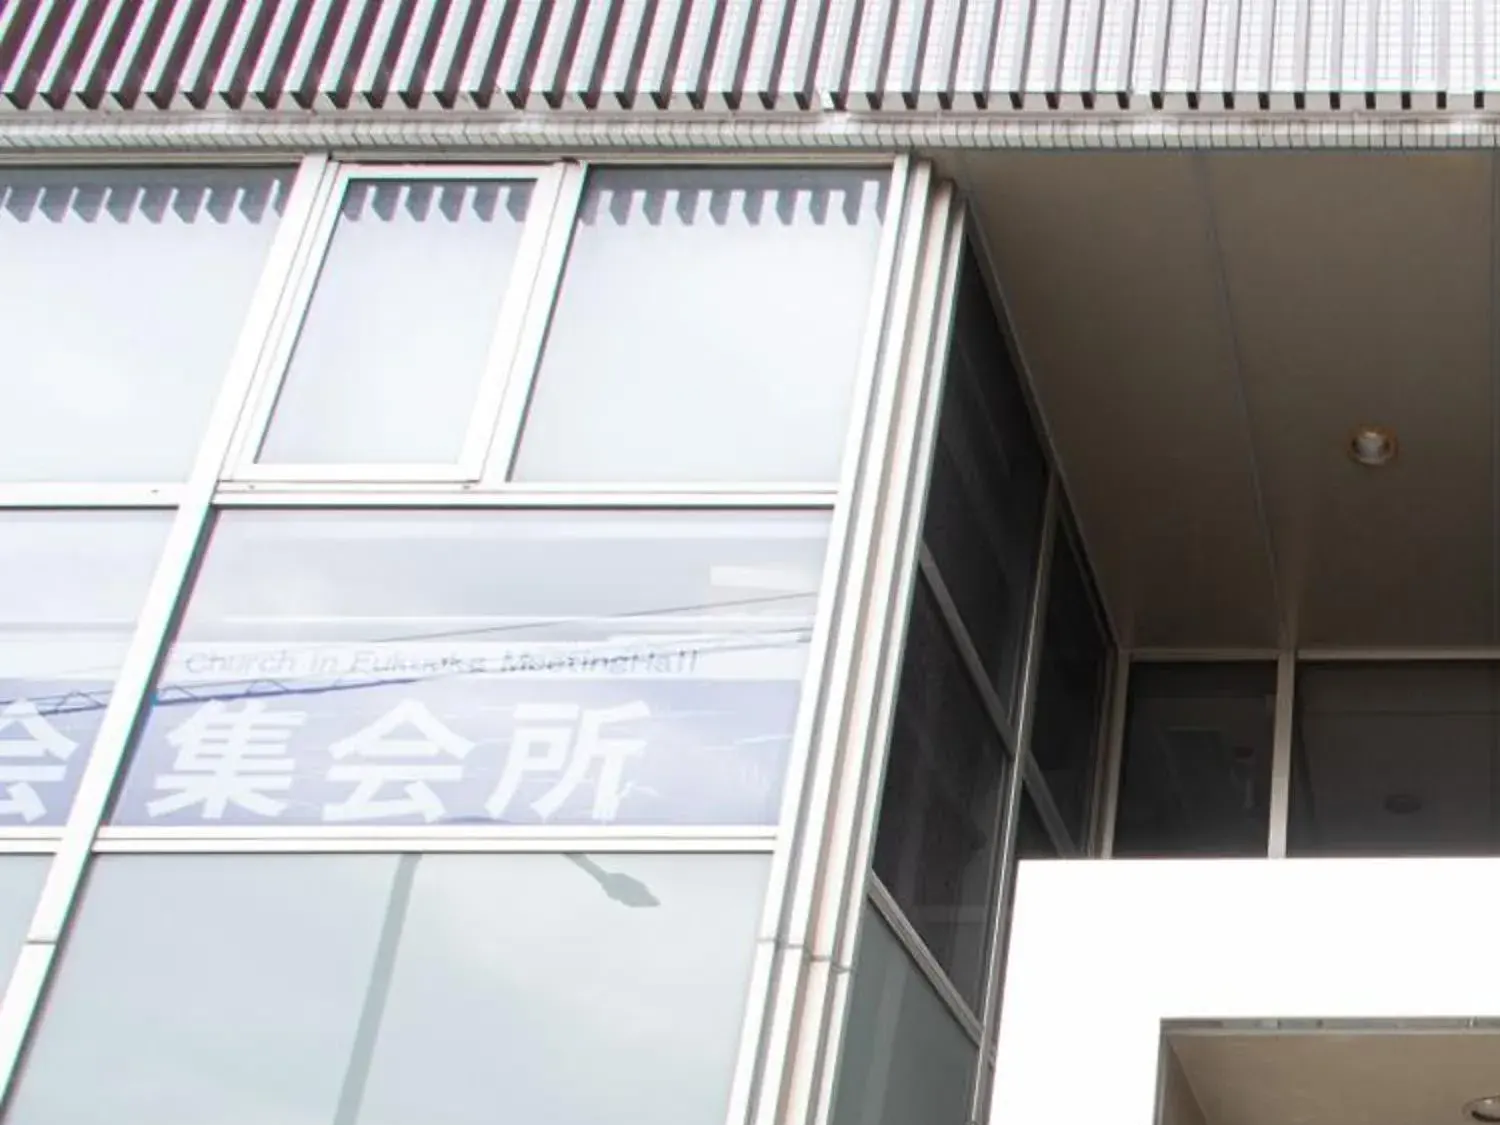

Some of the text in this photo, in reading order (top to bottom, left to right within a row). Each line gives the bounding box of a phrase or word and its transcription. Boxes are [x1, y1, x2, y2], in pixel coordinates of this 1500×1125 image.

[185, 648, 297, 675] Church
[147, 699, 650, 822] 集会所
